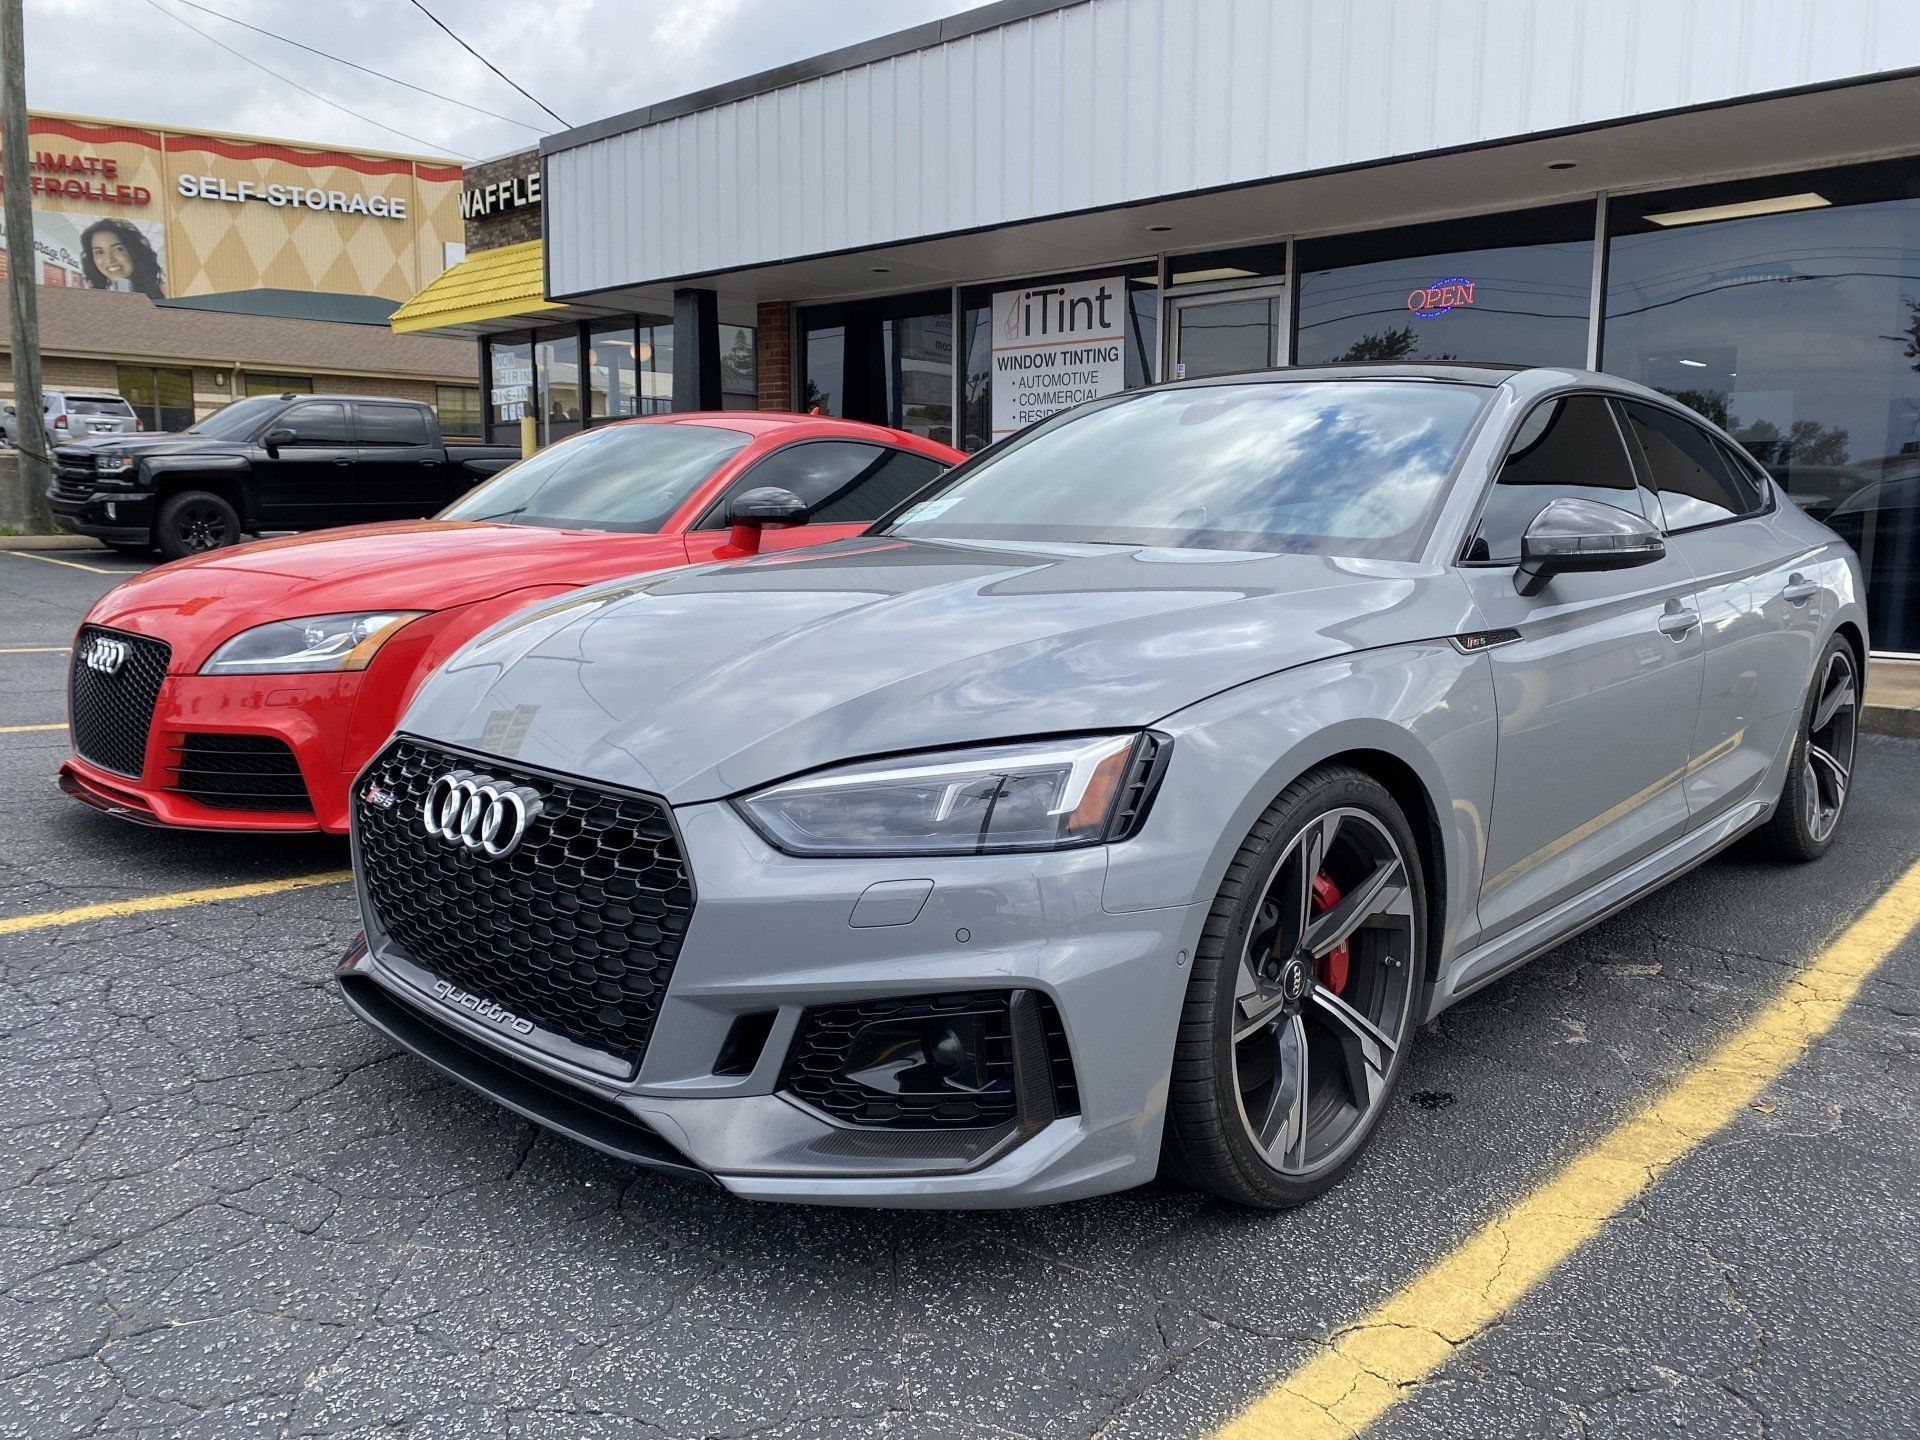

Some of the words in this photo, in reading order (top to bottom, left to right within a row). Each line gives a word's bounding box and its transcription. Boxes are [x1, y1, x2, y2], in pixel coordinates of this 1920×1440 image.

[0, 151, 118, 179] IMATE
[0, 175, 152, 206] TROLLED
[177, 174, 407, 220] SELF-STORAGE
[457, 172, 541, 220] WAFFLE
[33, 240, 60, 262] orage
[1025, 285, 1112, 336] iTint
[1407, 283, 1475, 311] OPEN
[997, 352, 1057, 371] WINDOW
[1060, 346, 1119, 366] TINTING
[500, 370, 531, 384] HIRIN
[1018, 370, 1099, 389] AUTOMOTIVE
[433, 979, 535, 1036] quattro
